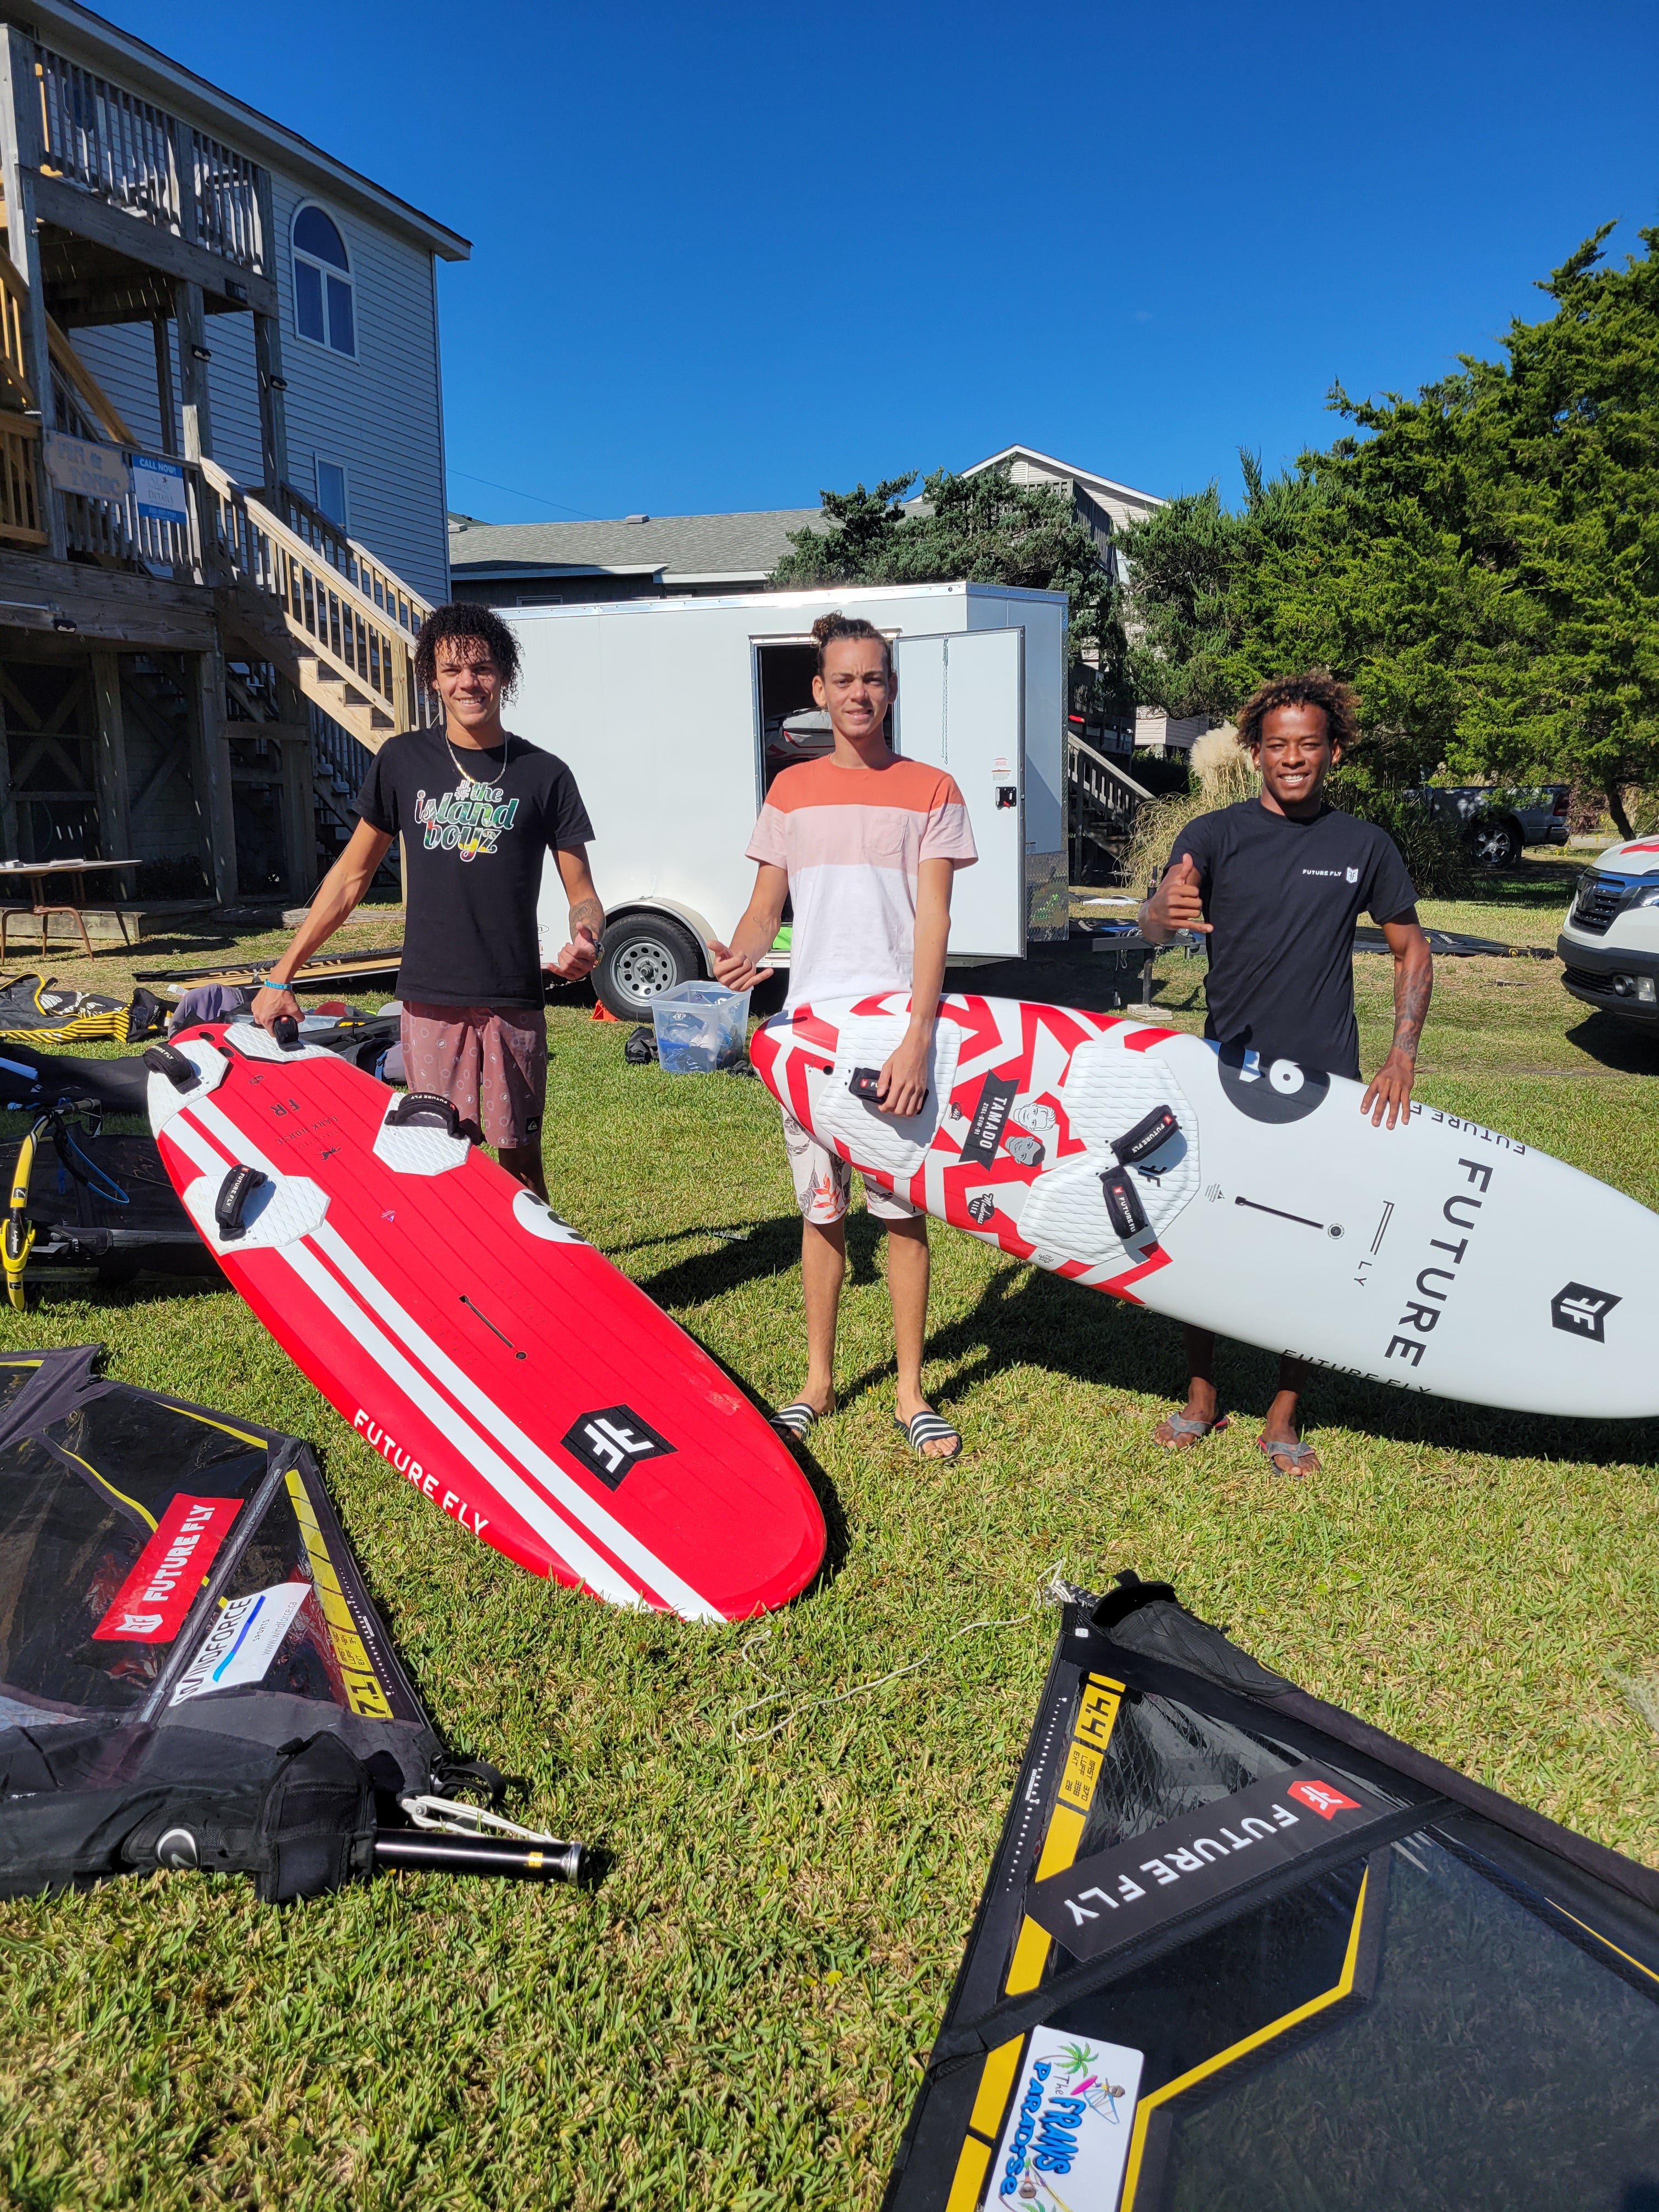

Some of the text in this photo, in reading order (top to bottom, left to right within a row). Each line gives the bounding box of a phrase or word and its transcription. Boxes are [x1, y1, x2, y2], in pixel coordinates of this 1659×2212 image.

[140, 458, 176, 476] CALL NOW!
[454, 779, 504, 803] #the
[415, 790, 520, 830] island
[424, 821, 502, 862] boyz
[269, 1098, 301, 1116] FR
[424, 1094, 448, 1104] FUTURE
[275, 1127, 309, 1145] HORSE
[311, 1116, 338, 1130] DARK
[979, 1097, 1008, 1149] TAMADO
[1131, 1123, 1165, 1154] FUTURE FLY
[1431, 1109, 1526, 1155] FUTURE
[226, 1173, 245, 1207] FUTURE FLY
[977, 1194, 993, 1224] Madness
[1119, 1197, 1134, 1224] FUTURE
[1385, 1158, 1493, 1367] FUTURE
[354, 1408, 489, 1536] FUTURE FLY
[143, 1504, 216, 1601] FUTURE FLY
[252, 1619, 270, 1643] SPORTS
[262, 1601, 297, 1656] www.windforce.ca
[345, 1649, 356, 1665] LUFF
[355, 1654, 365, 1666] EXT
[350, 1681, 386, 1715] 7.1
[1080, 1696, 1111, 1739] 4.4
[1065, 1751, 1080, 1791] EXT 28
[1079, 1755, 1088, 1775] LUFF
[1081, 1759, 1096, 1802] MAST 370
[1064, 1803, 1300, 1926] FUTURE FLY
[1053, 2075, 1070, 2095] The
[1033, 2097, 1087, 2175] FRANS
